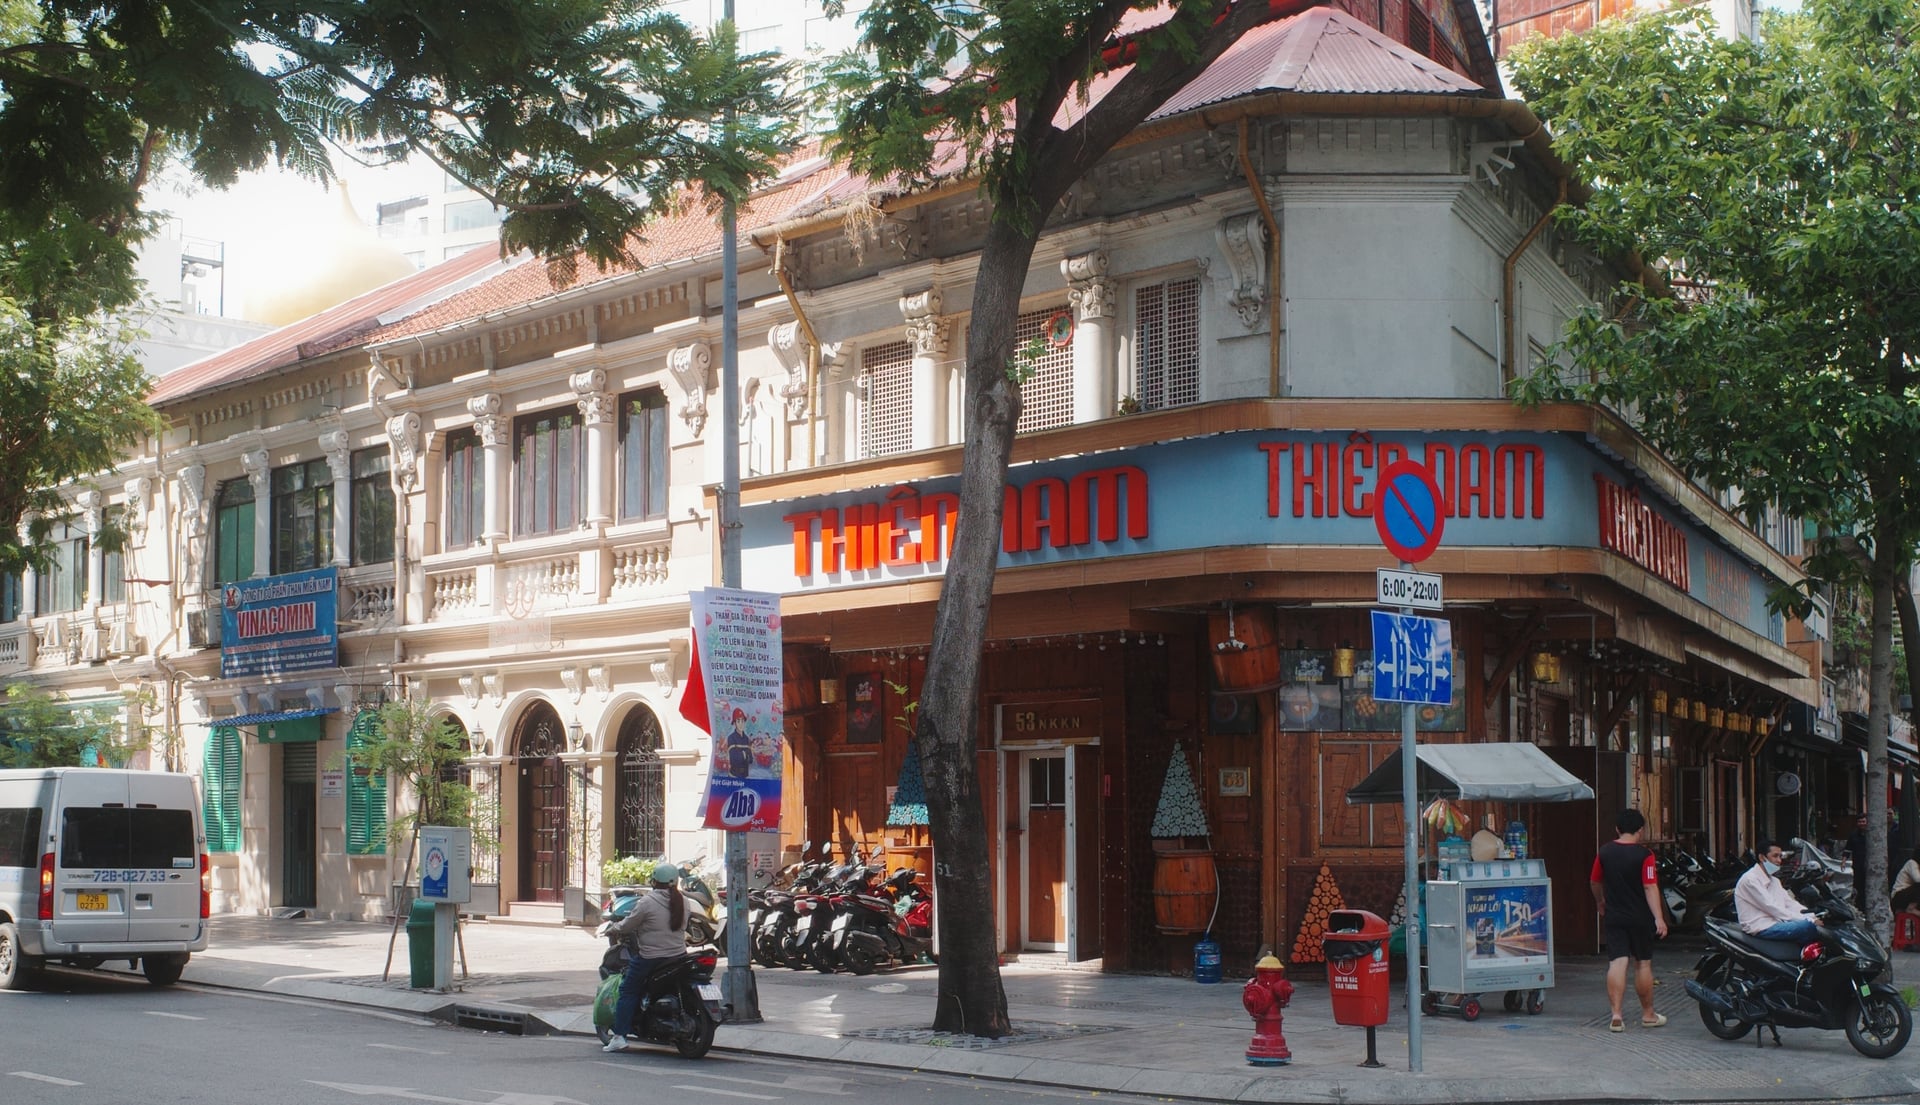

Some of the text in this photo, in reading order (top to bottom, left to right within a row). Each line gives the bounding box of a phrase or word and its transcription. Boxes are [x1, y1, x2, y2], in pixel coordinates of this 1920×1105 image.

[1258, 432, 1409, 518] THIÊ
[237, 601, 316, 639] VINACOMIN
[1015, 711, 1035, 732] 53
[725, 791, 755, 818] Aba
[93, 870, 166, 882] 72B-027.33
[1467, 903, 1486, 913] KHAI
